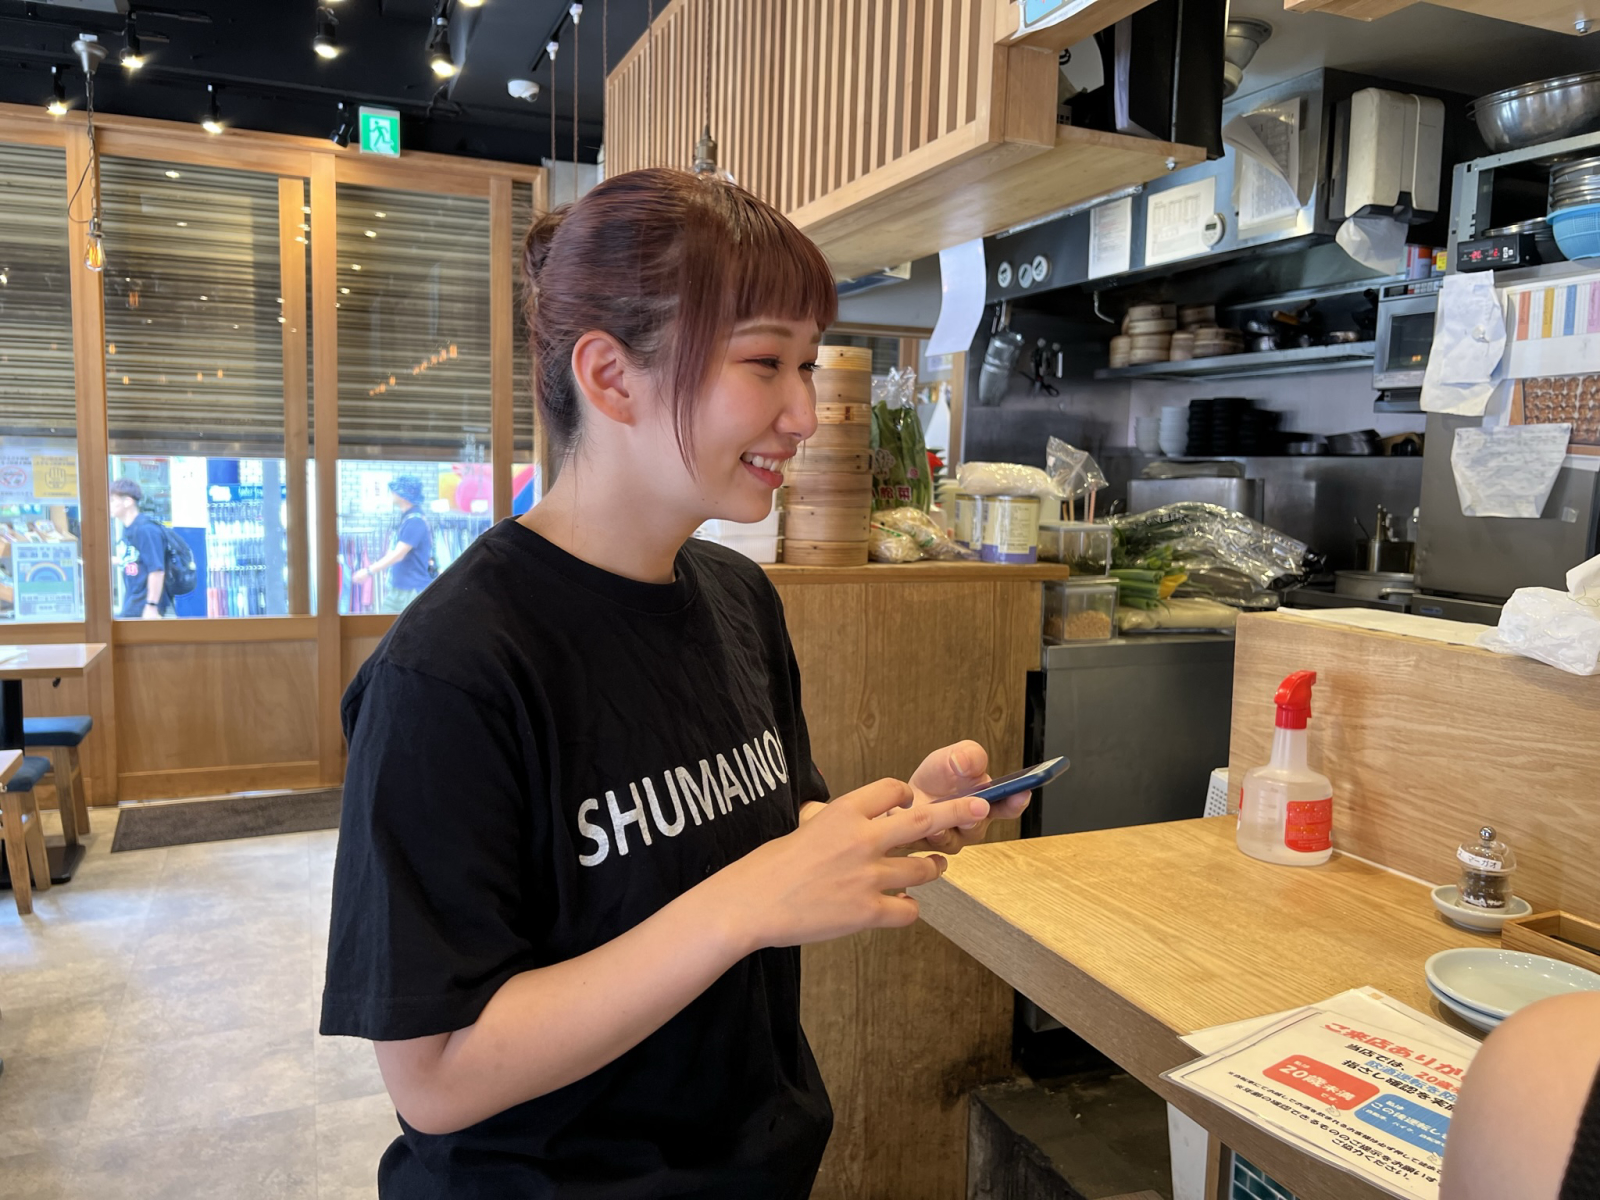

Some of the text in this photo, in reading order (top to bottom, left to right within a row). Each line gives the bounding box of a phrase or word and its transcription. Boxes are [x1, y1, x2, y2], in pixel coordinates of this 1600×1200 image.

[577, 726, 789, 867] SHUMAINO
[1324, 1022, 1467, 1081] ご来店ありが
[1278, 1064, 1355, 1100] 20歳未満
[1331, 1137, 1410, 1180] ご協力ください。
